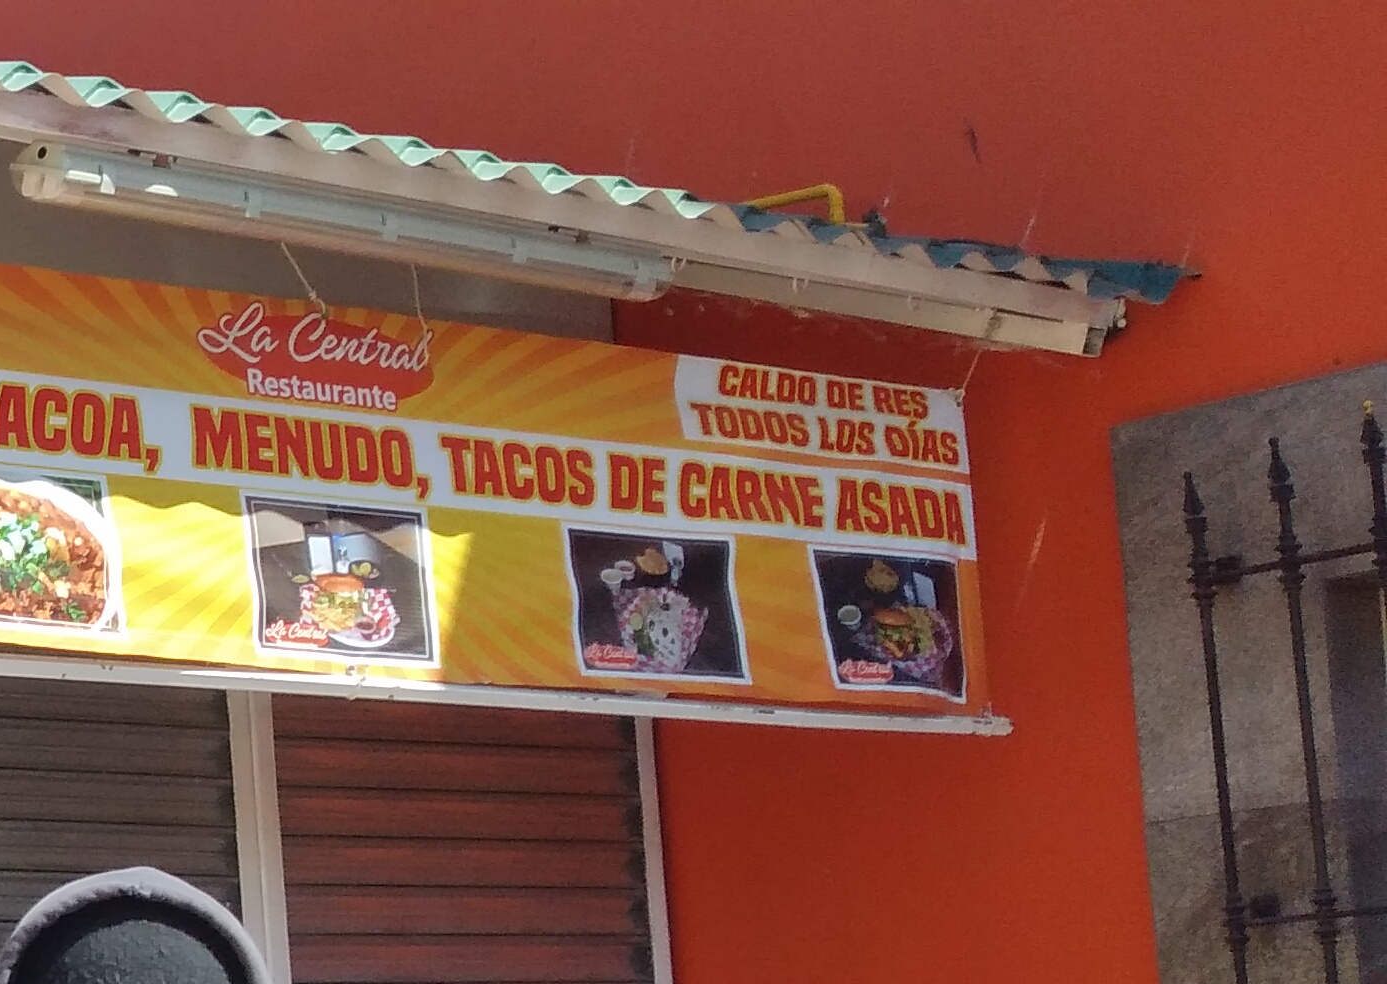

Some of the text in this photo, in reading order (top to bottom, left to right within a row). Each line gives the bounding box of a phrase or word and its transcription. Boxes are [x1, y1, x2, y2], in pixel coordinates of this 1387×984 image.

[196, 302, 433, 373] La Central
[245, 367, 399, 412] Restaurante
[717, 364, 929, 419] CALDO DE RES
[692, 402, 960, 467] TODOS LOS DÍAS
[192, 404, 431, 500] MENUDO,
[439, 432, 596, 510] TACOS
[607, 450, 667, 518] DE
[679, 460, 823, 531] CARNE
[835, 477, 967, 546] ASADA
